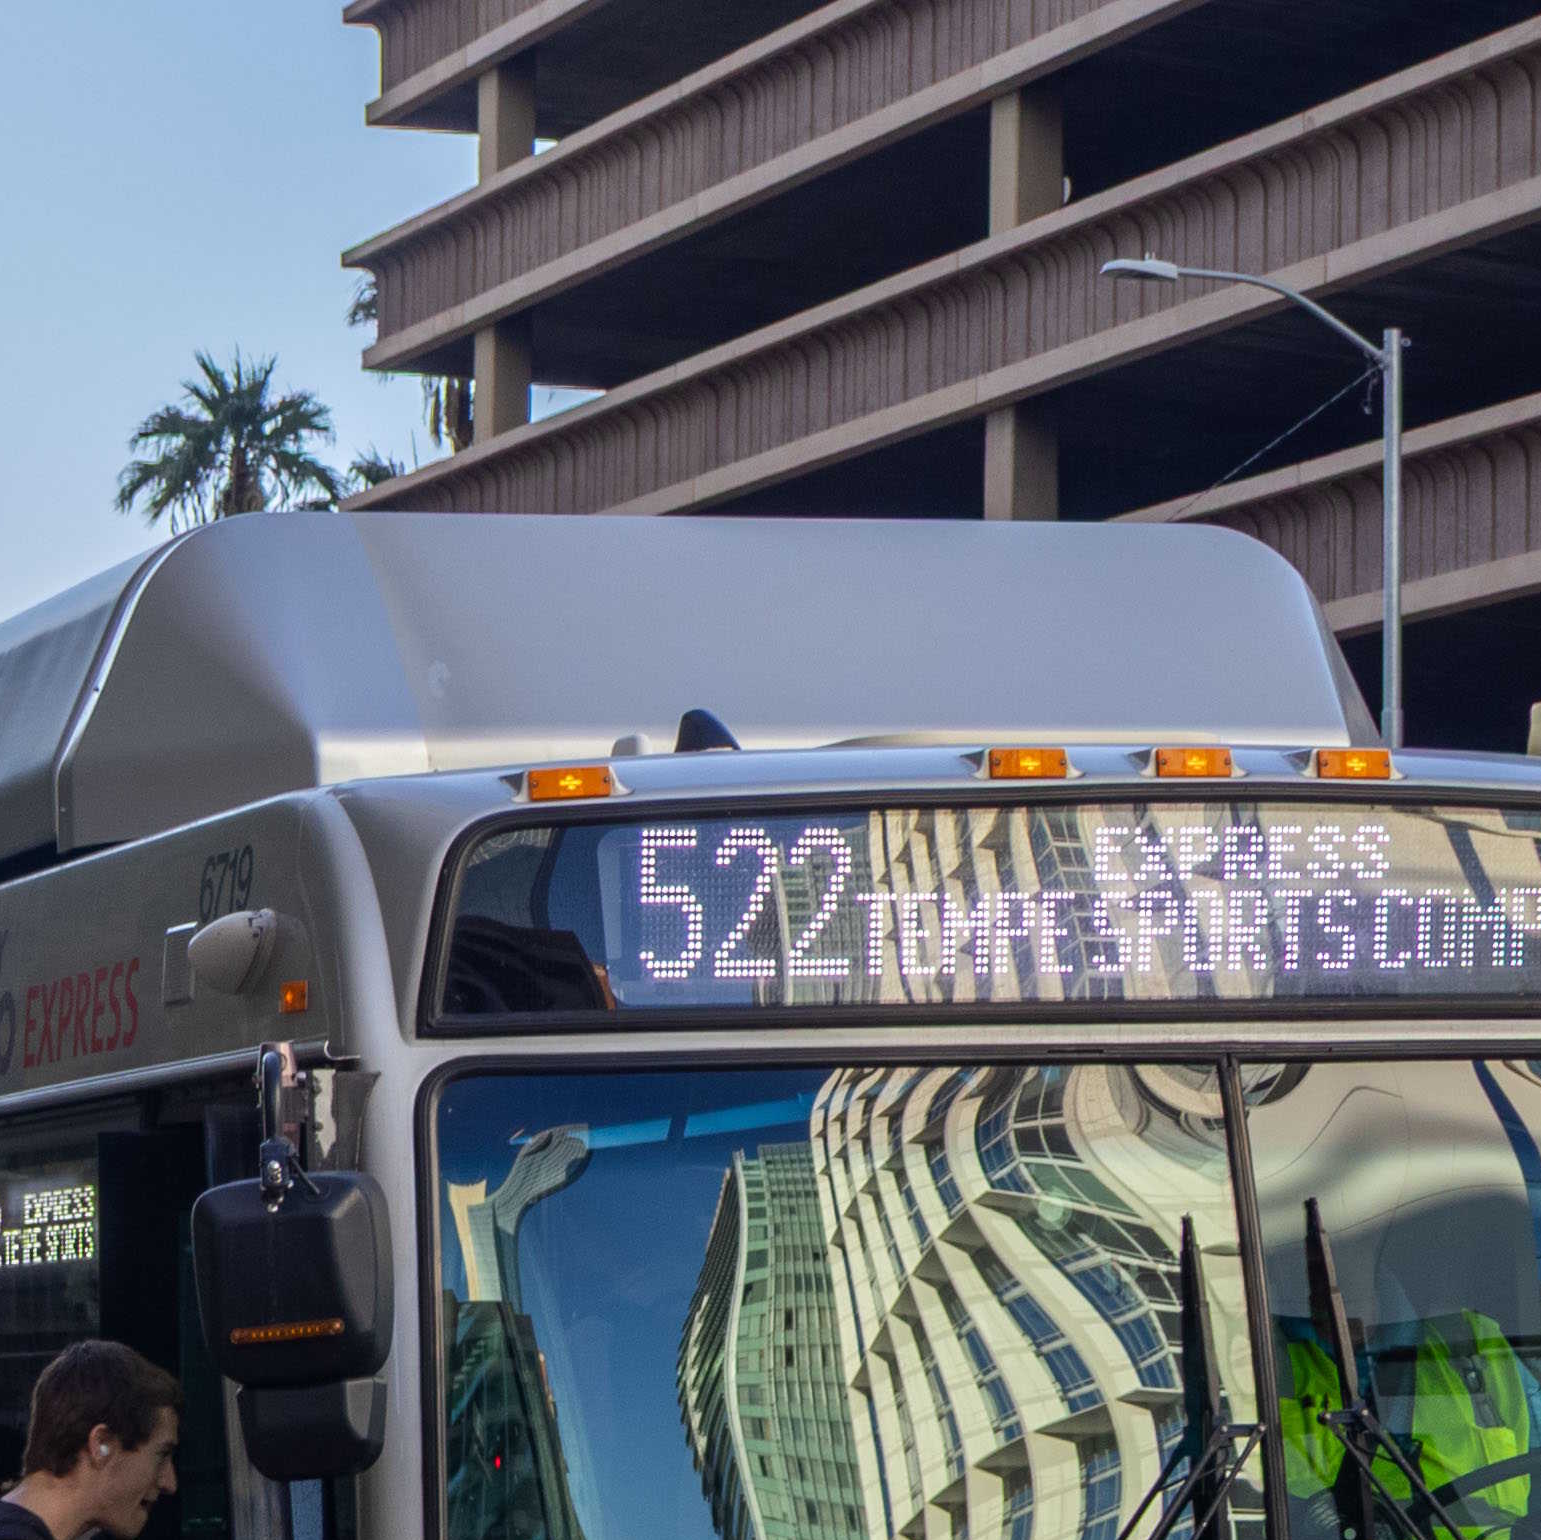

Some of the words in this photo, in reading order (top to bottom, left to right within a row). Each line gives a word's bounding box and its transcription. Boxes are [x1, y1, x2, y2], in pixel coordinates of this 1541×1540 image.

[200, 845, 253, 923] 6719
[1094, 825, 1391, 882] EXPRESS
[639, 827, 853, 978] 522
[857, 891, 1076, 975] TEMPE
[1092, 888, 1358, 973] SPORTS
[23, 957, 141, 1069] EXPRESS
[24, 1185, 94, 1225] EXPRESS
